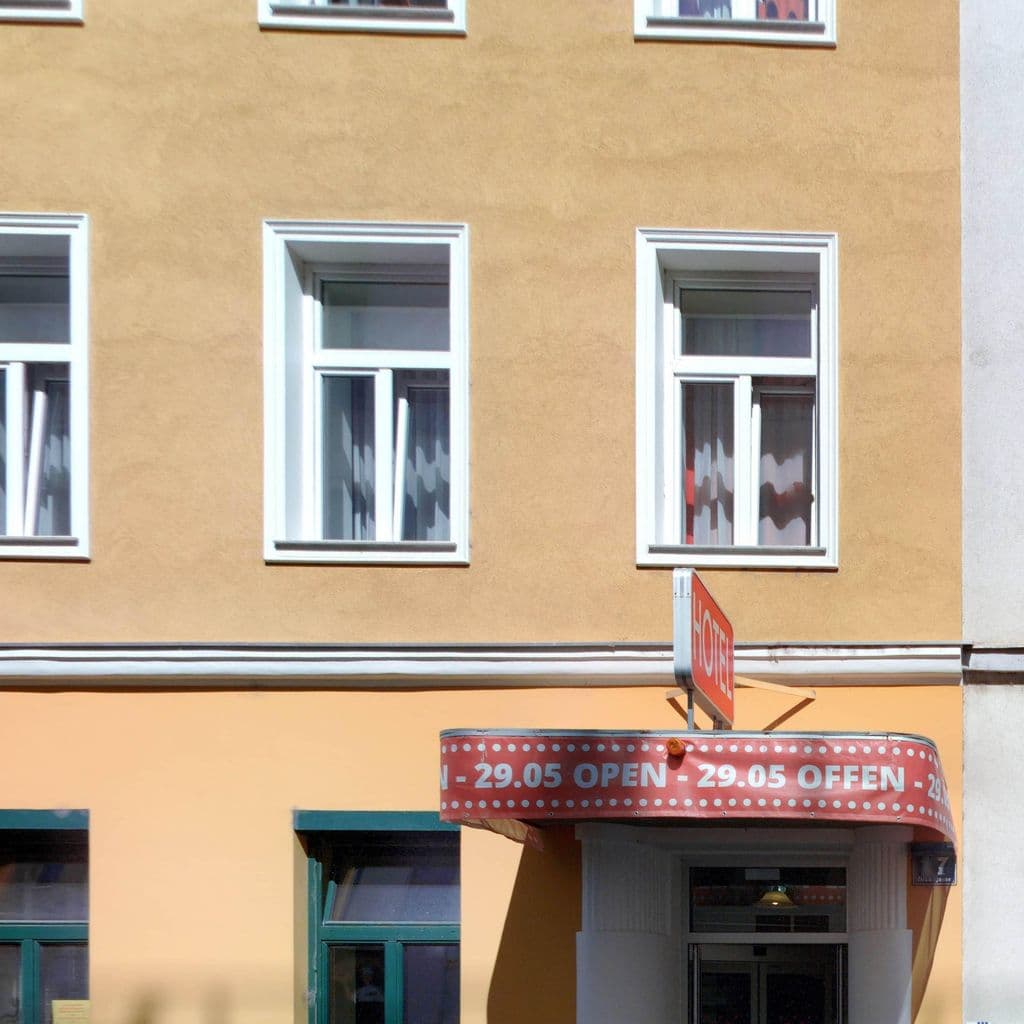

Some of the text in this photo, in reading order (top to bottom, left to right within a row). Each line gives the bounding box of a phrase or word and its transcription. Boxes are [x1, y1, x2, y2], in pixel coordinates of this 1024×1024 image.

[692, 591, 733, 701] HOTEL
[474, 762, 562, 789] 29.05
[573, 762, 668, 789] OPEN
[697, 763, 786, 789] 29.05
[797, 764, 905, 792] OFFEN
